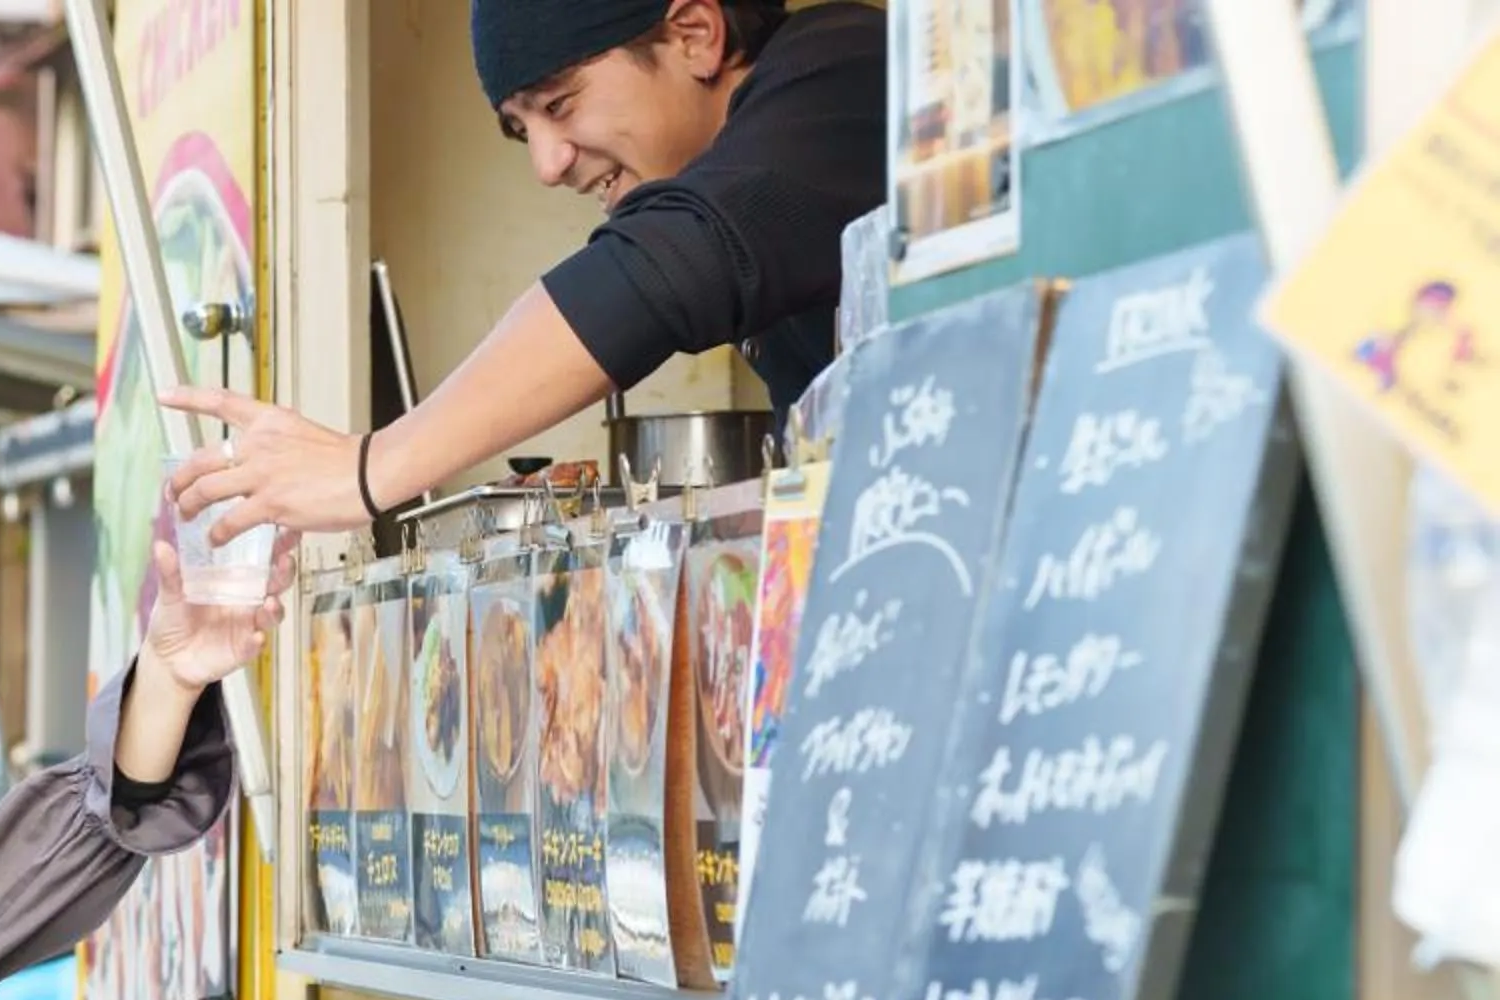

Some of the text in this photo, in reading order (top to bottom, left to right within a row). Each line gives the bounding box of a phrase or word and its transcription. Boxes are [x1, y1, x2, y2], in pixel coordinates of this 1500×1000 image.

[542, 828, 603, 873] チキンステーキ
